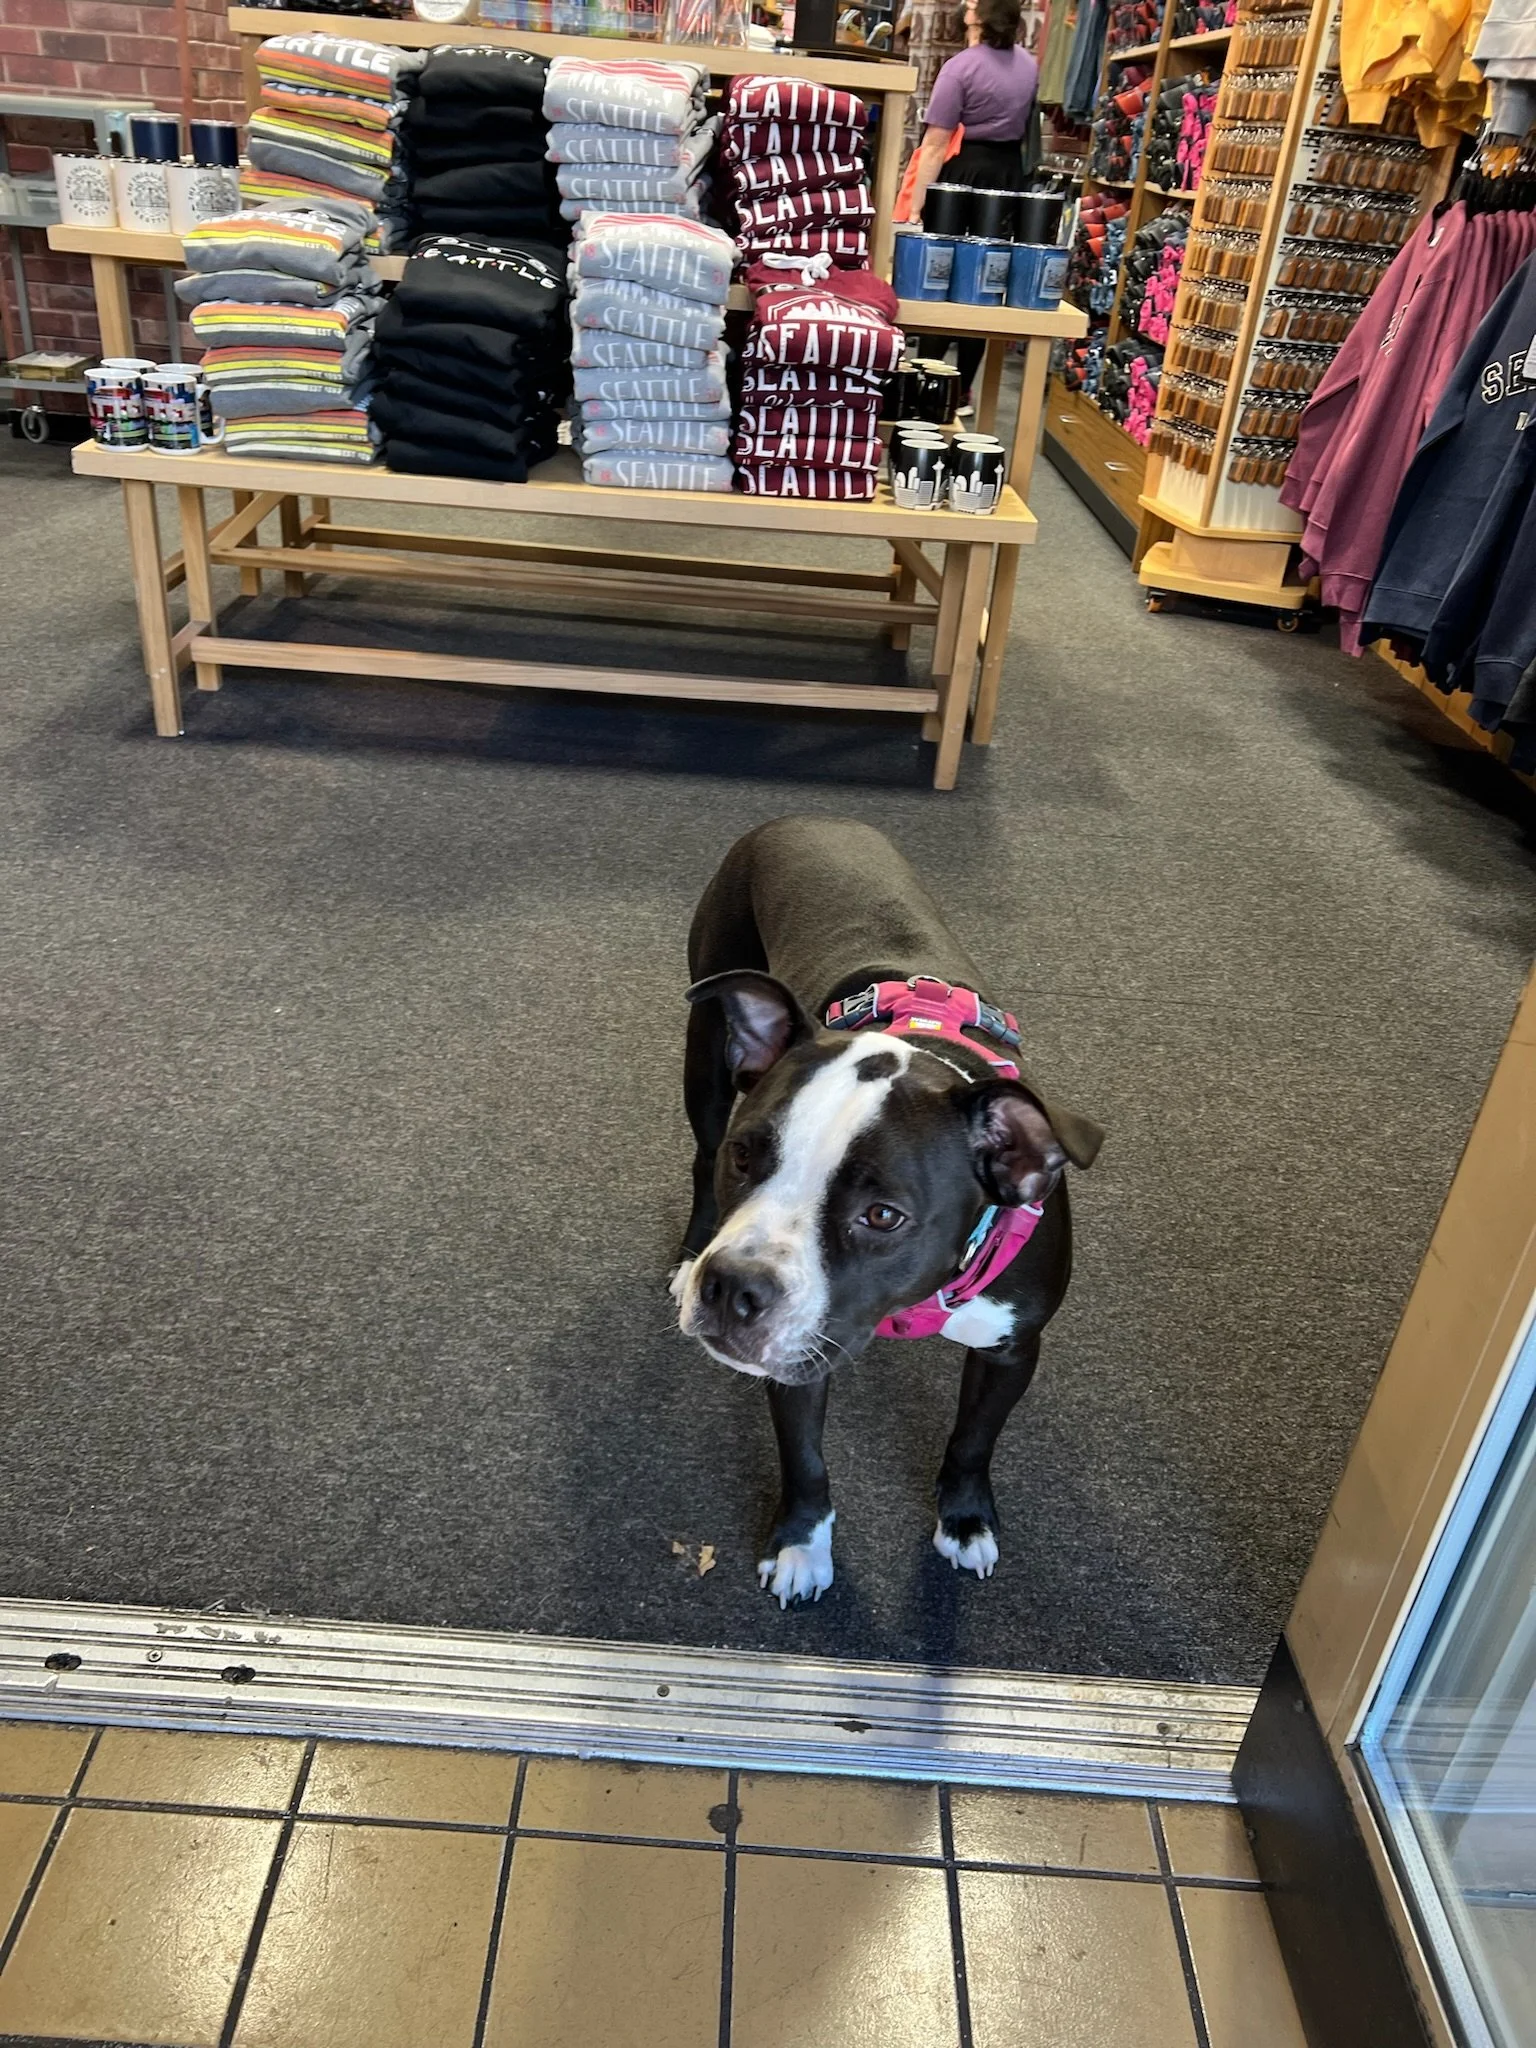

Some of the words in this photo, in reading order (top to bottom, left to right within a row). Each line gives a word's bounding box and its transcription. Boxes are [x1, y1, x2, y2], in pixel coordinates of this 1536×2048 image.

[264, 35, 398, 74] EATTLE
[565, 97, 670, 133] SEATTLE
[565, 138, 666, 166] SEATTLE
[571, 177, 670, 202] SEATTLE
[600, 238, 711, 290] SEATTLE
[603, 307, 711, 349] SEATTLE
[592, 342, 696, 368] SEATTLE
[600, 378, 701, 403] SEATTLE
[1481, 349, 1536, 405] SE
[611, 421, 711, 451] SEATTLE
[616, 460, 717, 491] SEATTLE
